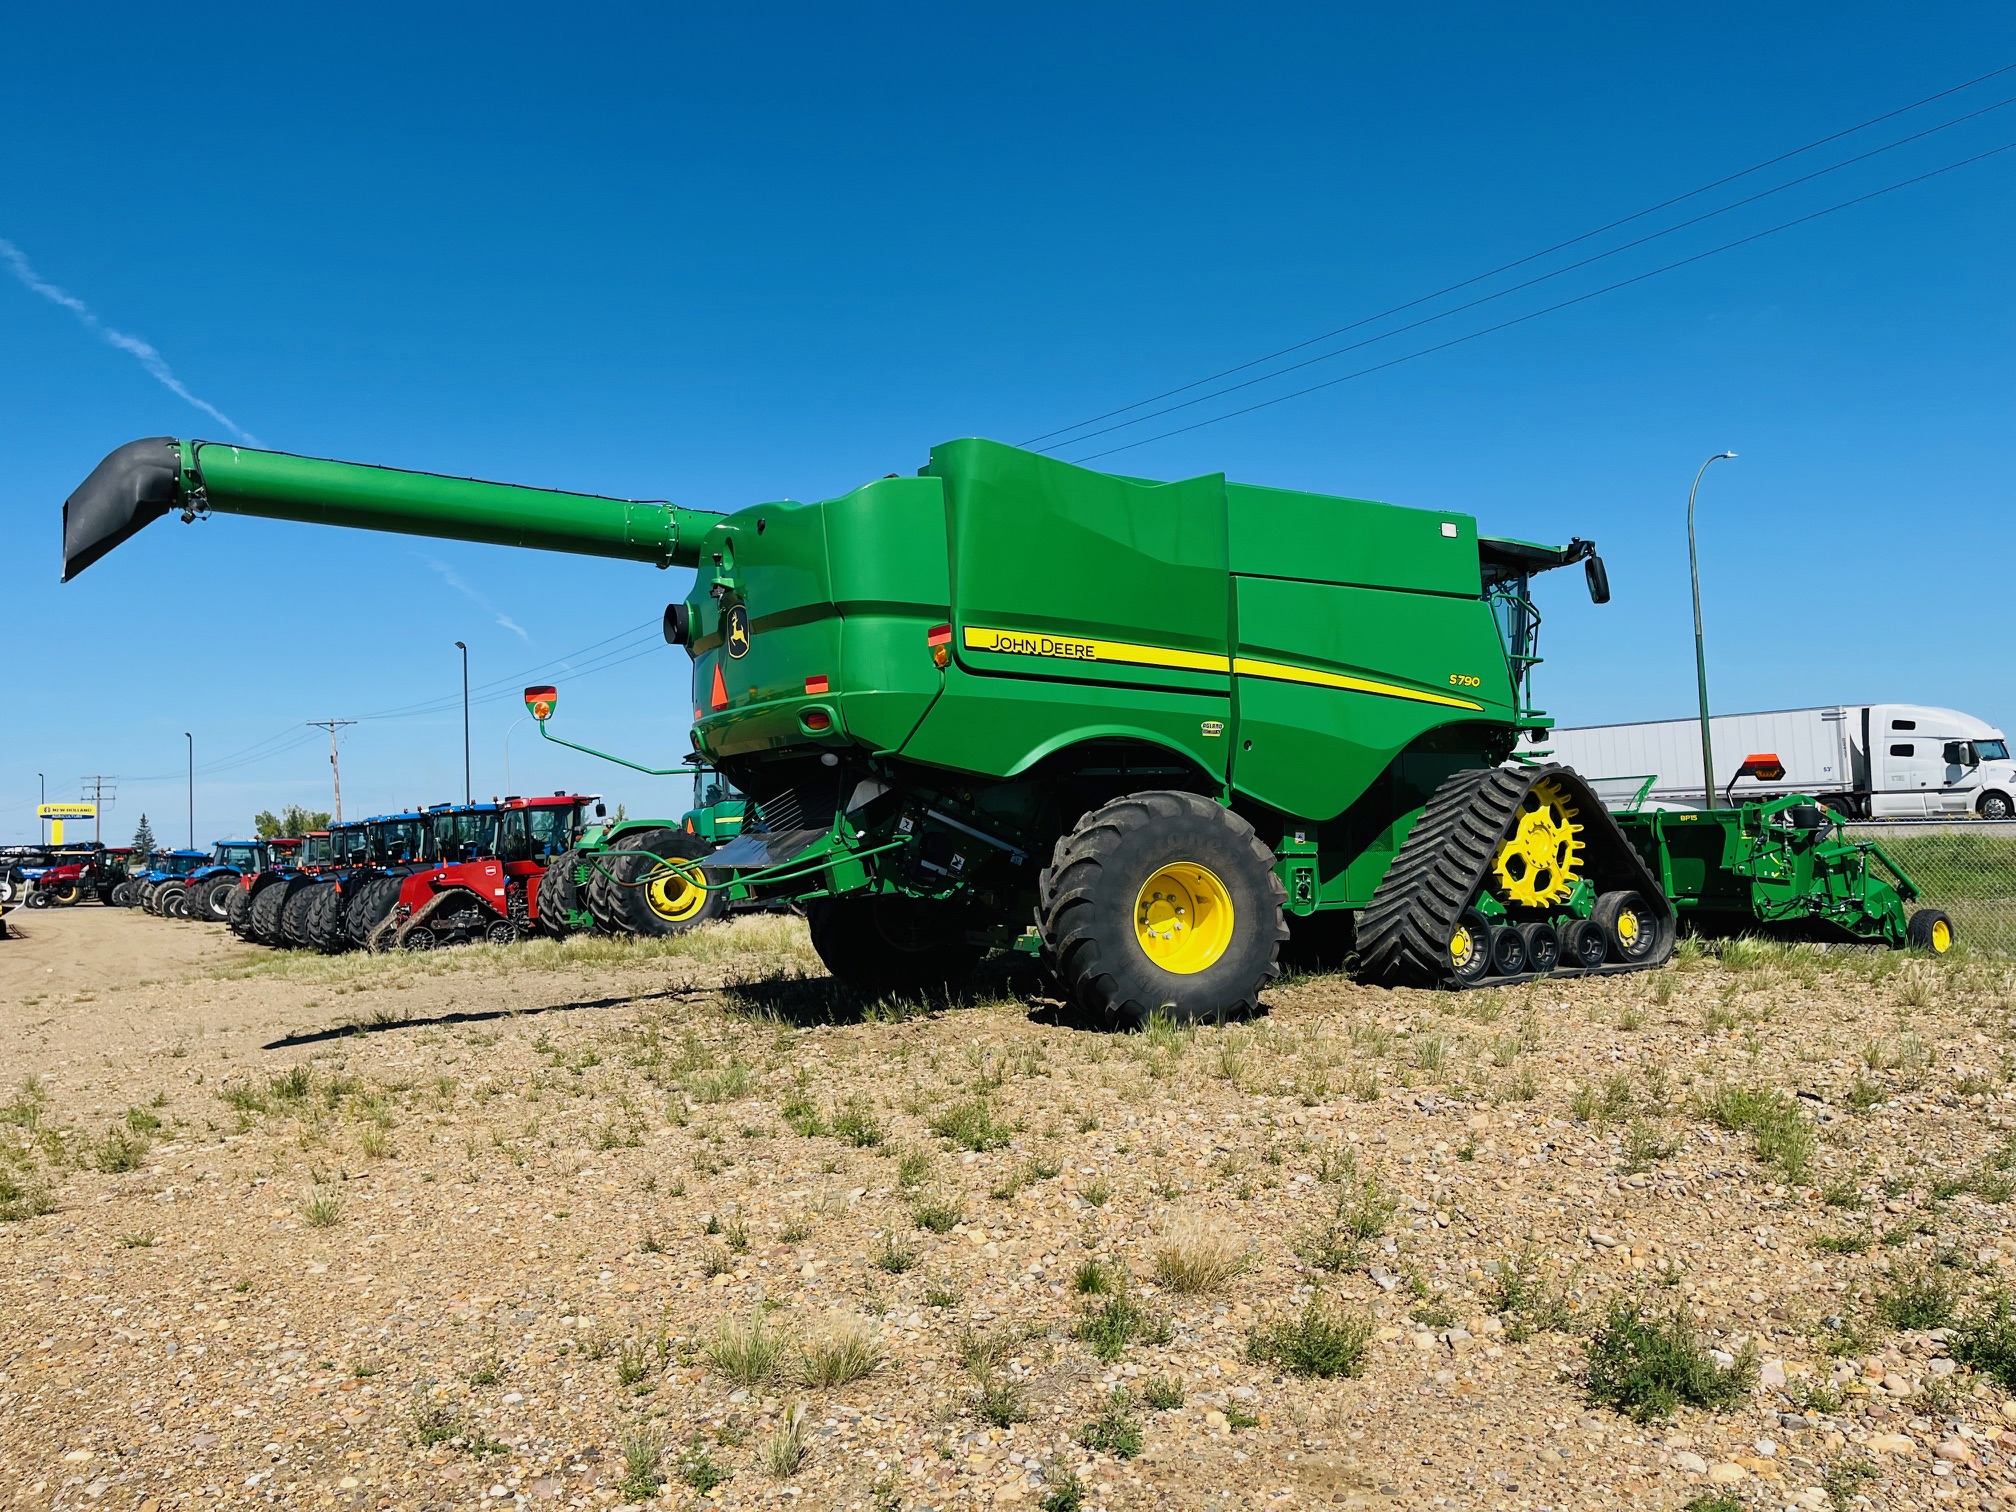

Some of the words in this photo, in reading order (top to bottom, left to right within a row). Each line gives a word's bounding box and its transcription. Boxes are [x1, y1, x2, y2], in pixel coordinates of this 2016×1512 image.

[990, 634, 1037, 653] JOHN
[1041, 638, 1096, 658] DEERE
[1449, 674, 1481, 687] S790
